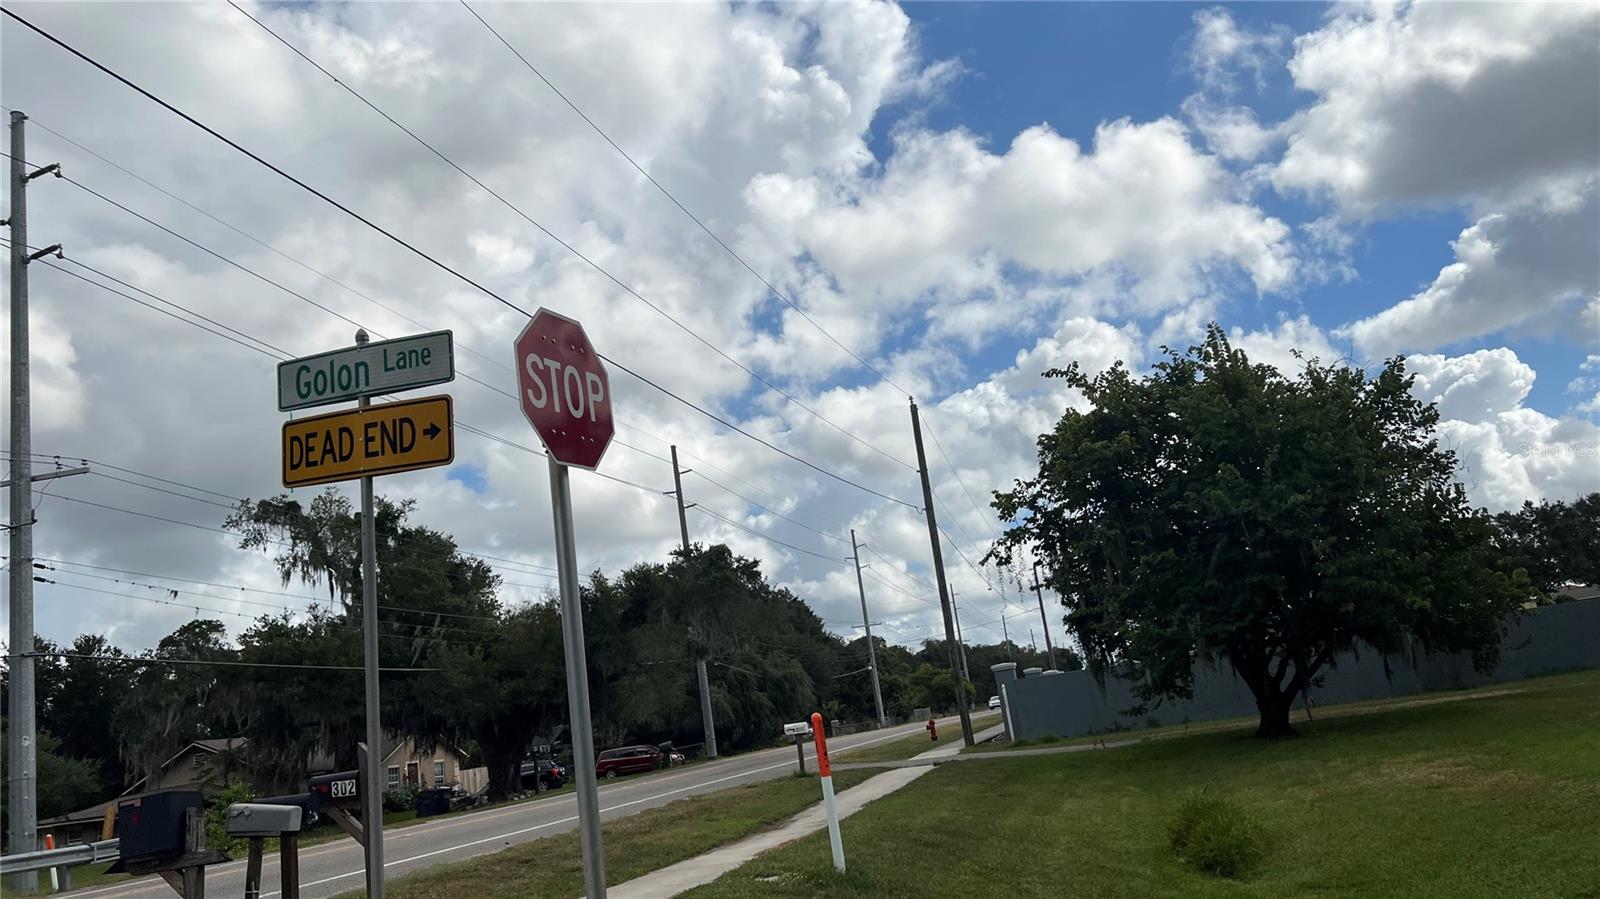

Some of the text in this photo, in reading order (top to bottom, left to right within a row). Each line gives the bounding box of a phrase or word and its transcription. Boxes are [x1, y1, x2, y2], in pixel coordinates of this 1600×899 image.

[296, 347, 431, 400] Golon Lane
[525, 353, 604, 422] STOP
[289, 416, 417, 471] DEAD END
[332, 780, 355, 796] 302
